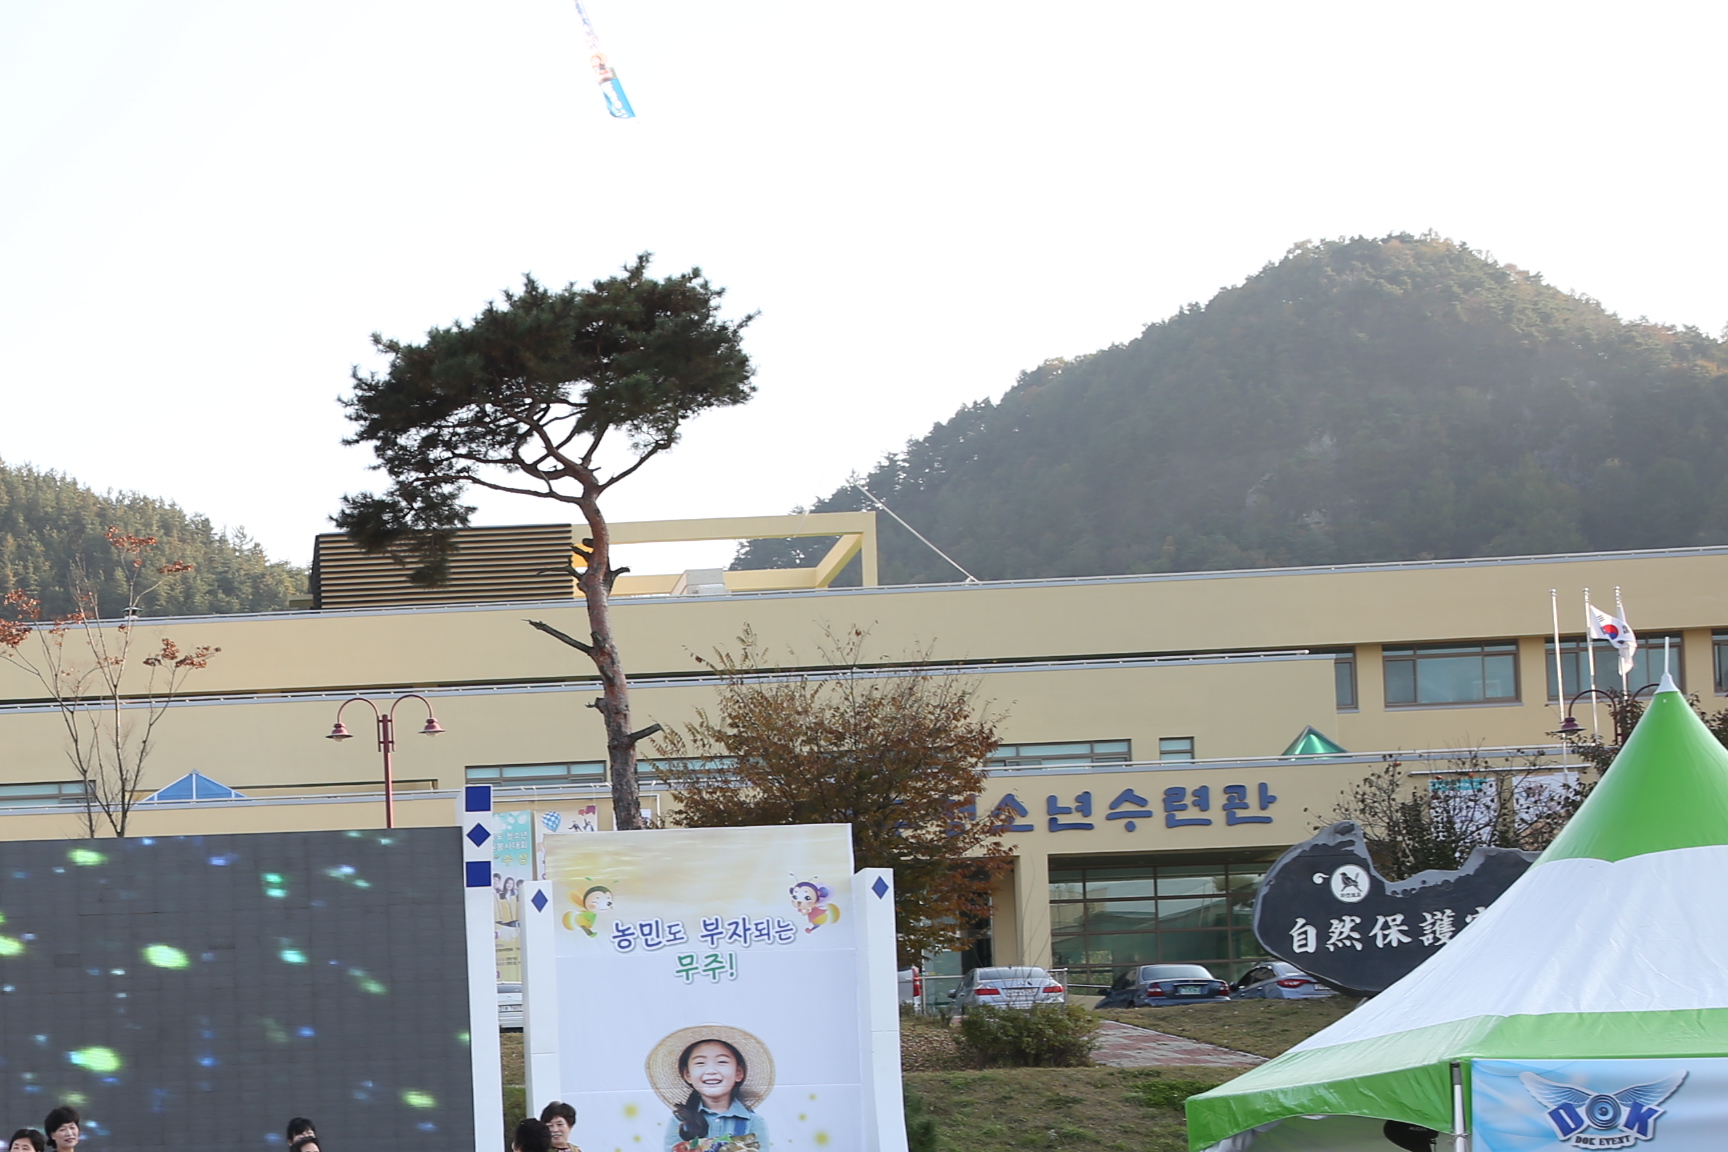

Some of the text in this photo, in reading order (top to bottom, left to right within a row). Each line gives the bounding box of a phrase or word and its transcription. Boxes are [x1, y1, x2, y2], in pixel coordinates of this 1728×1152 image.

[890, 782, 1278, 836] 청소년수련관
[611, 917, 796, 949] 농민도 부자되는
[1289, 906, 1487, 954] 自然保護
[675, 953, 736, 982] 무주!
[1575, 1135, 1632, 1146] DOK EVENT
